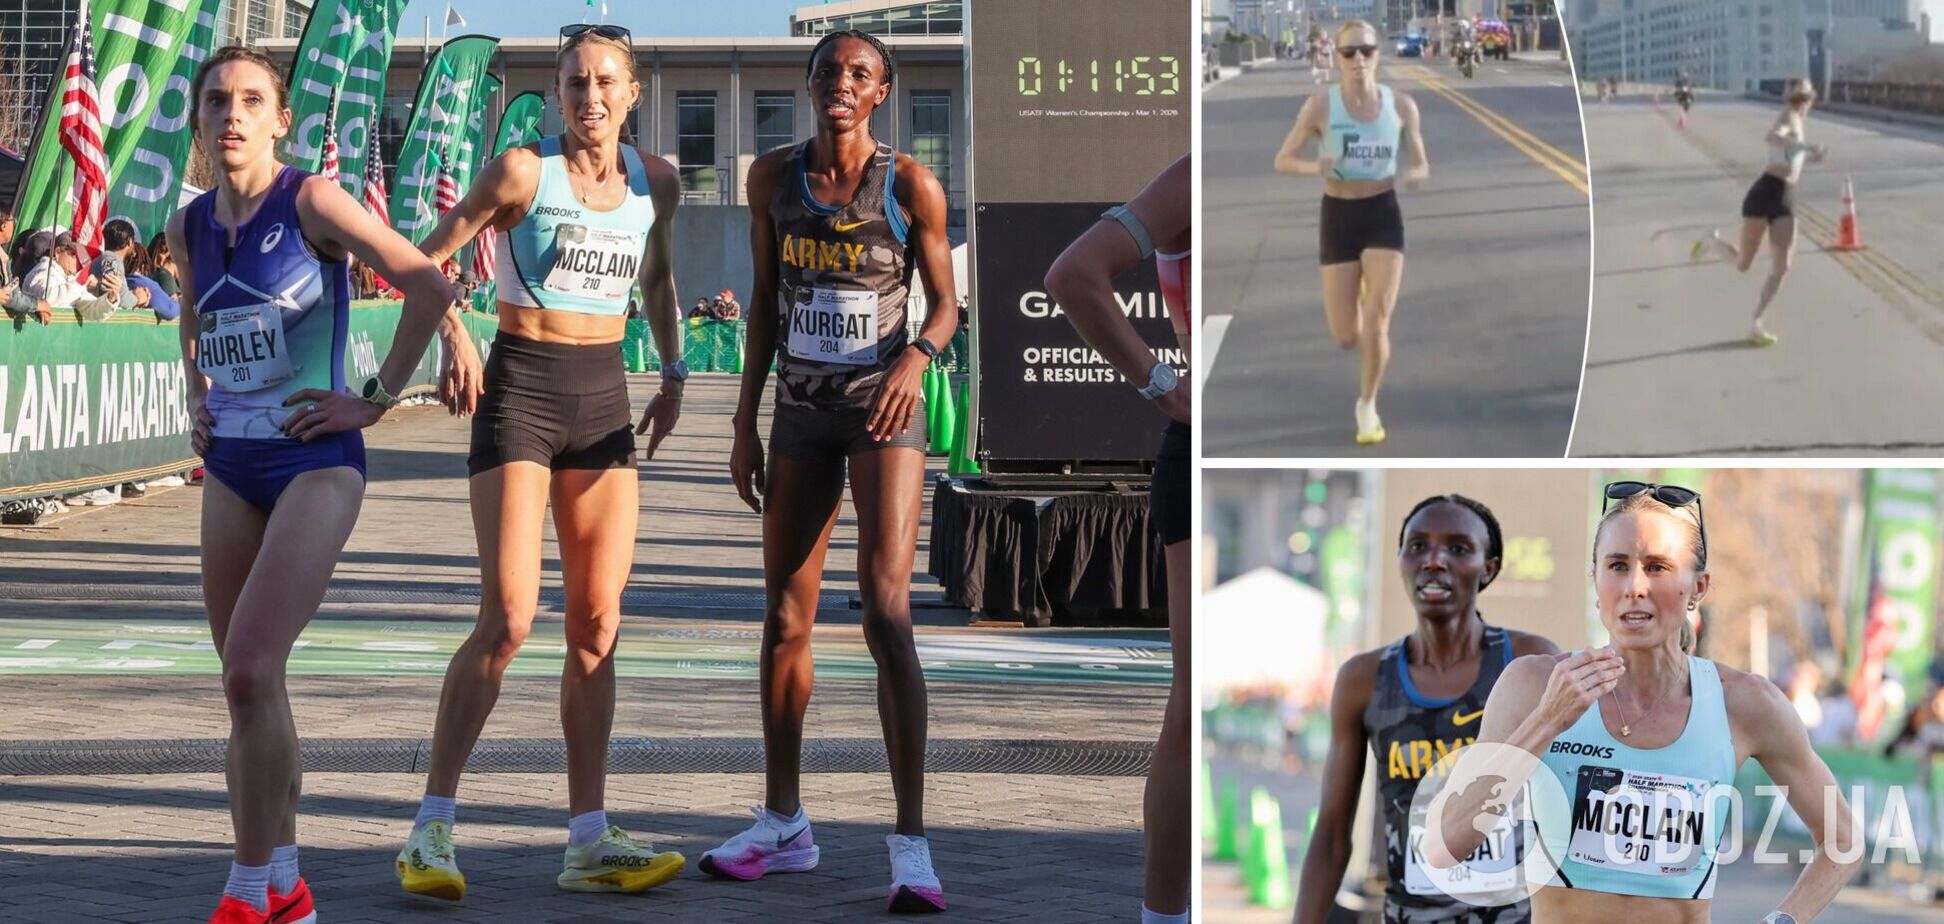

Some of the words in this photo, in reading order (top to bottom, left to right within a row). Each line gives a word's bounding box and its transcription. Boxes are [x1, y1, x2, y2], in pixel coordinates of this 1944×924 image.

[1079, 109, 1130, 117] Championship
[535, 206, 581, 220] BROOKS
[782, 233, 865, 273] ARMY
[556, 247, 637, 279] MCCLAIN
[582, 277, 601, 291] 210
[793, 307, 872, 340] KURGAT
[200, 328, 276, 369] HURLEY
[820, 339, 839, 354] 204
[231, 366, 251, 383] 201
[1023, 368, 1038, 383] &
[1043, 368, 1115, 383] RESULTS
[97, 359, 194, 445] MARATHO
[1388, 737, 1477, 780] ARM
[1550, 741, 1615, 759] BROOKS
[1647, 781, 1687, 790] MARATHON
[1577, 798, 1704, 846] MCCLAIN
[1623, 842, 1650, 862] 210
[602, 855, 651, 868] BROOKS
